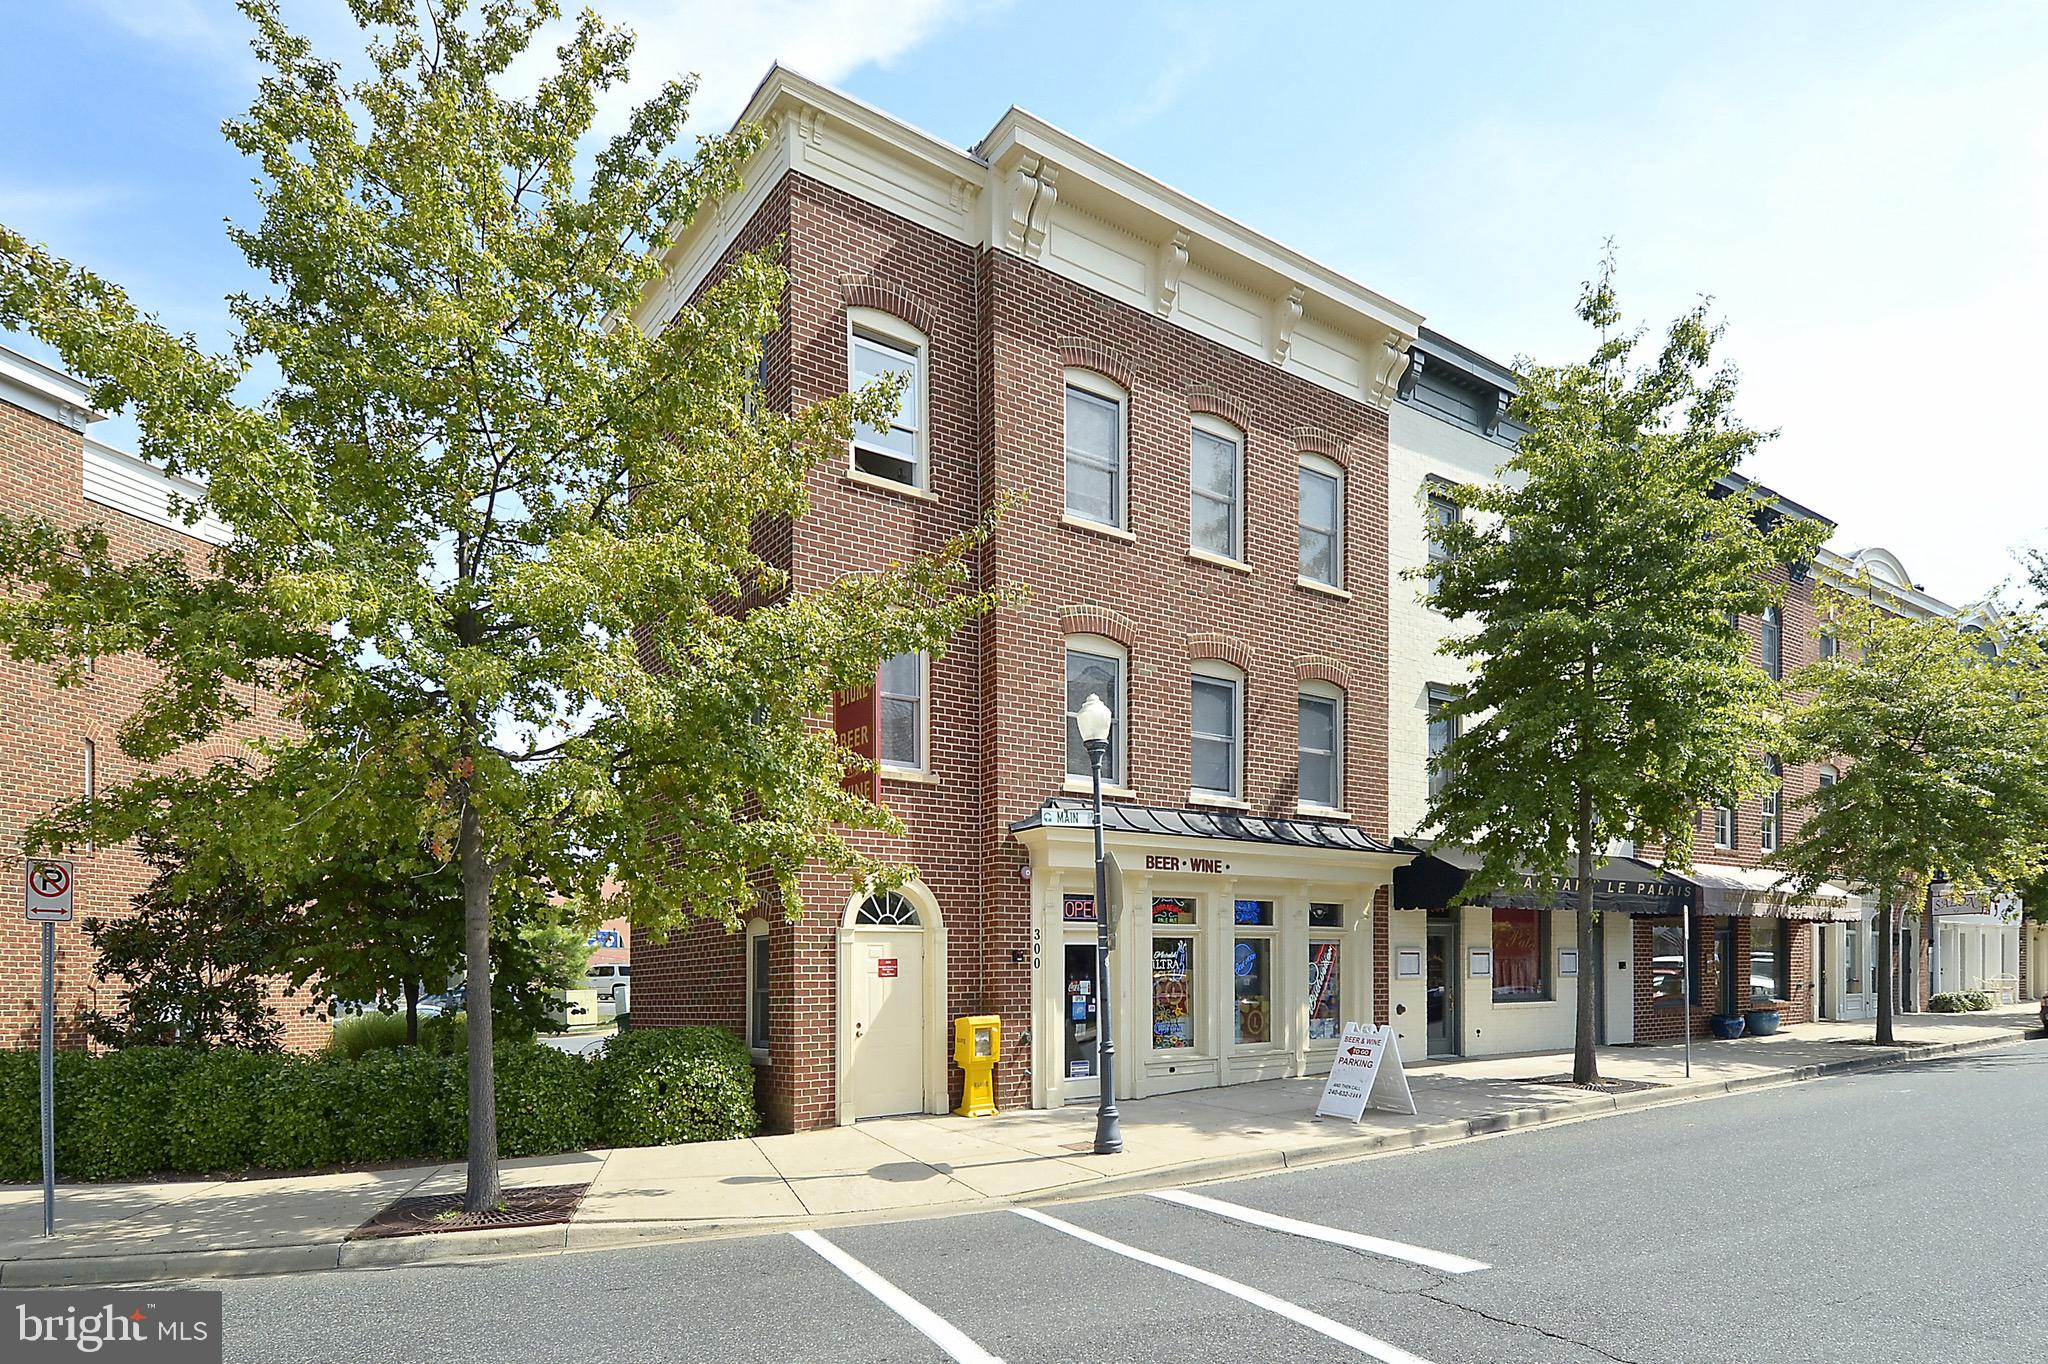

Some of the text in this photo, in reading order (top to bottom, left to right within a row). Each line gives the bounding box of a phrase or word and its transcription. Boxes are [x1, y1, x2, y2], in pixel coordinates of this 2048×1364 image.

[840, 725, 869, 749] BEER
[1057, 811, 1079, 824] MAIN
[1145, 855, 1222, 873] BEER WINE
[1607, 881, 1626, 893] LE
[1637, 883, 1691, 897] PALAIS
[1033, 928, 1041, 969] 300
[1344, 1035, 1361, 1044] BEER
[1366, 1039, 1382, 1047] WINE
[1338, 1056, 1374, 1069] PARKING
